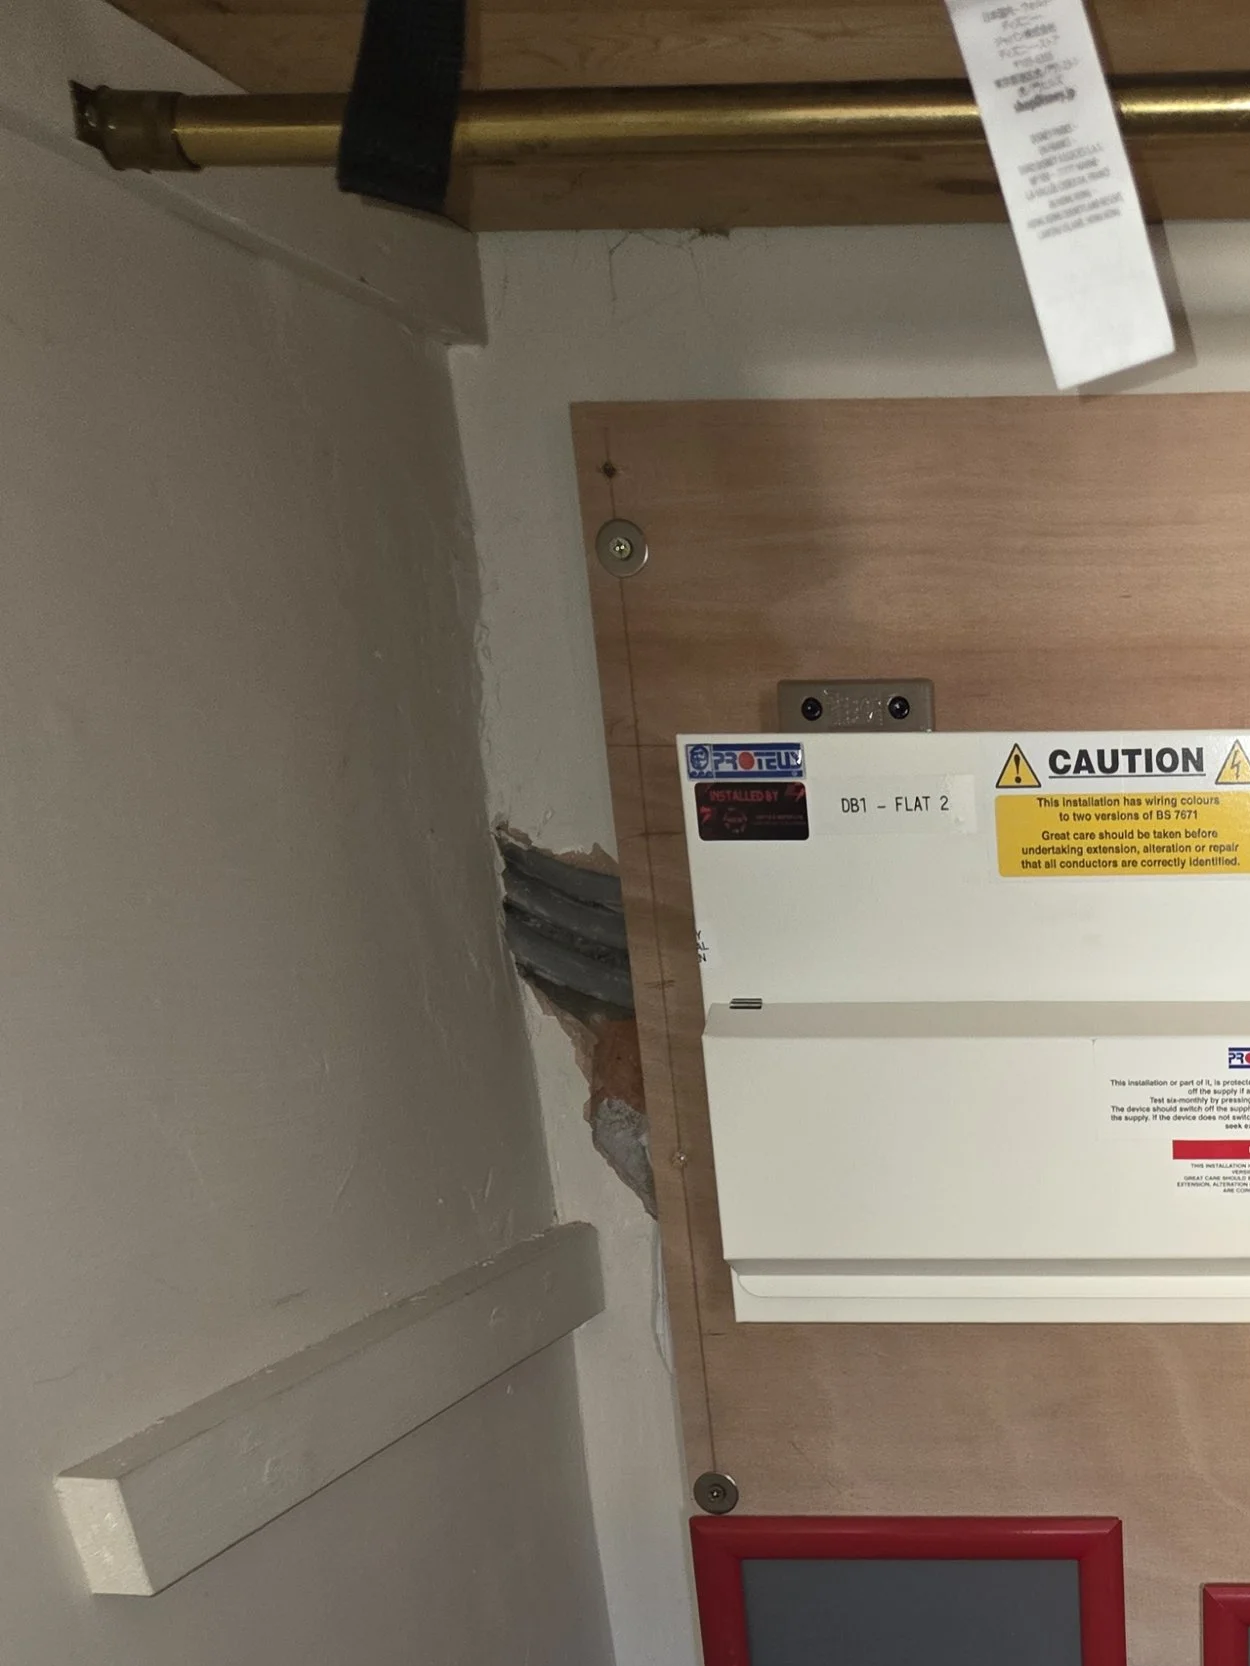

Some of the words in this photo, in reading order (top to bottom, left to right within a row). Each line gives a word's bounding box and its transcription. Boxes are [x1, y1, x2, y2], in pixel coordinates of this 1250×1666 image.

[1049, 747, 1204, 775] CAUTION
[841, 797, 867, 813] DB1
[895, 796, 930, 812] FLAT
[940, 795, 949, 811] 2
[1037, 798, 1059, 808] This
[1062, 798, 1120, 807] installation
[1123, 797, 1142, 806] has
[1144, 796, 1177, 808] wiring
[1181, 796, 1220, 806] colours
[1059, 812, 1070, 822] to
[1073, 812, 1091, 821] two
[1093, 811, 1139, 821] versions
[1142, 810, 1153, 820] of
[1156, 810, 1171, 820] BS
[1174, 810, 1197, 820] 7671
[1041, 830, 1070, 840] Great
[1073, 832, 1096, 840] care
[1099, 830, 1133, 839] should
[1137, 830, 1150, 839] be
[1153, 829, 1181, 839] taken
[1184, 829, 1218, 839] before
[1022, 845, 1083, 856] undertaking
[1086, 845, 1140, 855] extension,
[1143, 844, 1191, 854] alteration
[1194, 845, 1205, 853] or
[1209, 843, 1239, 855] repair
[1021, 860, 1042, 869] that
[1044, 859, 1056, 869] all
[1059, 859, 1118, 869] conductors
[1121, 859, 1138, 868] are
[1141, 857, 1186, 869] correctly
[1189, 856, 1240, 867] identified.
[1213, 1088, 1237, 1096] supply
